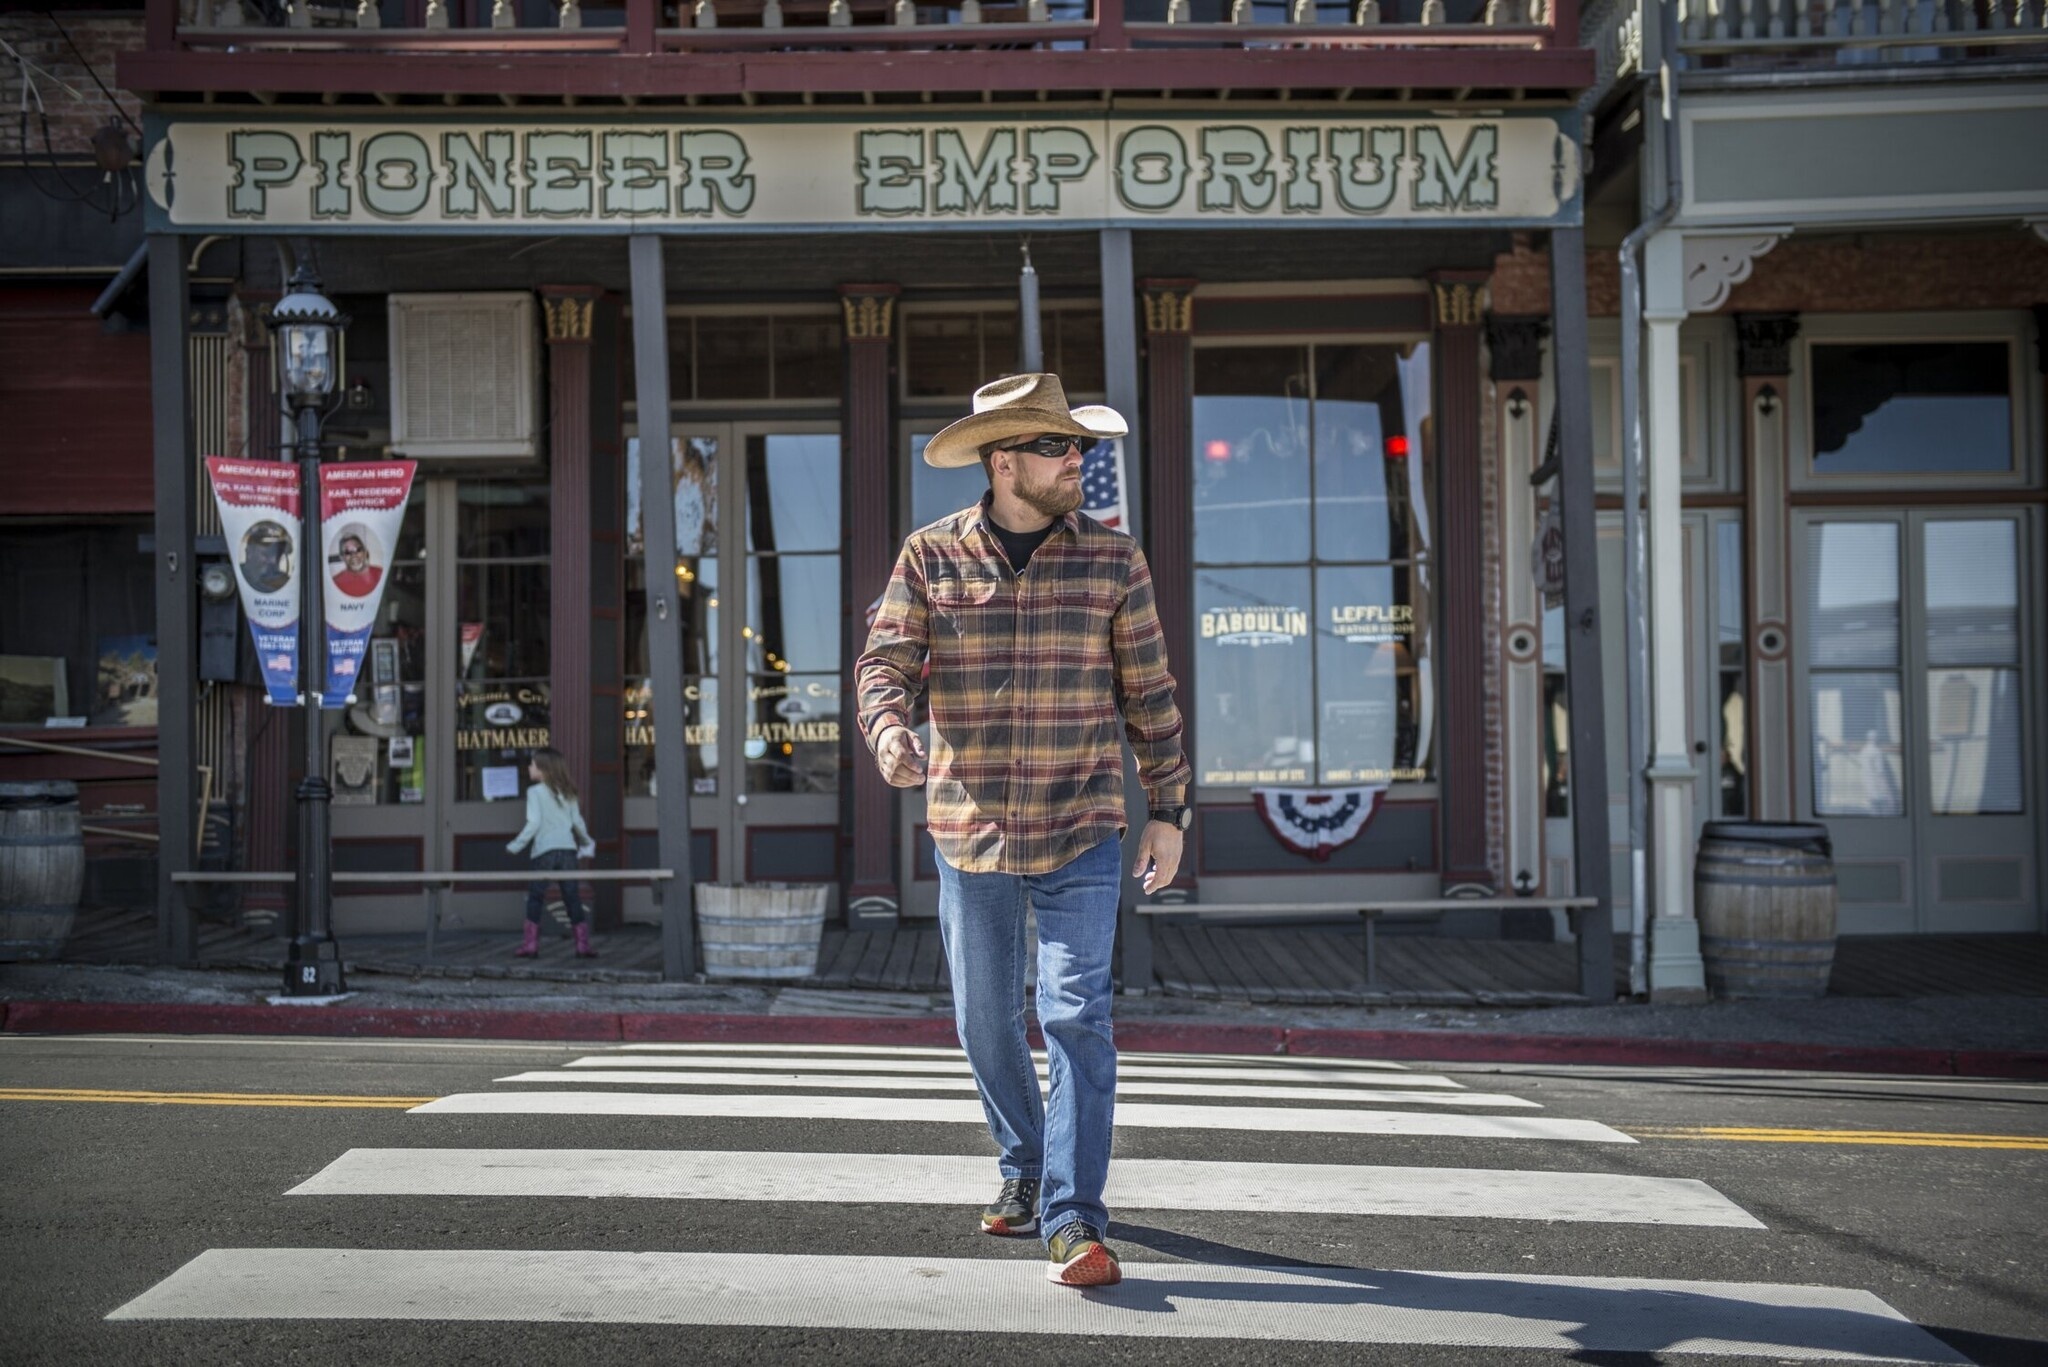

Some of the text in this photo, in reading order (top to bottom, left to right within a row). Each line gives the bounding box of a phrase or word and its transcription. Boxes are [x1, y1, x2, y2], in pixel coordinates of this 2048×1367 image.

[228, 122, 1500, 220] PIONEER EMPORIUM
[217, 463, 296, 479] AMERICAN HERO
[326, 467, 404, 480] AMERICAN HERO
[233, 484, 255, 494] KARL
[328, 486, 403, 498] KARL FREDERICK
[254, 598, 290, 607] MARINE
[340, 603, 365, 611] NAVY
[258, 610, 286, 618] CORP
[1332, 605, 1413, 623] LEFFLER
[1201, 611, 1308, 638] BABOULIN
[1333, 622, 1415, 635] LEATHER GOODS
[458, 691, 510, 709] VIRGINIA
[457, 727, 549, 750] HATMAKER
[748, 721, 839, 743] HATMAKER
[303, 966, 316, 983] 82
